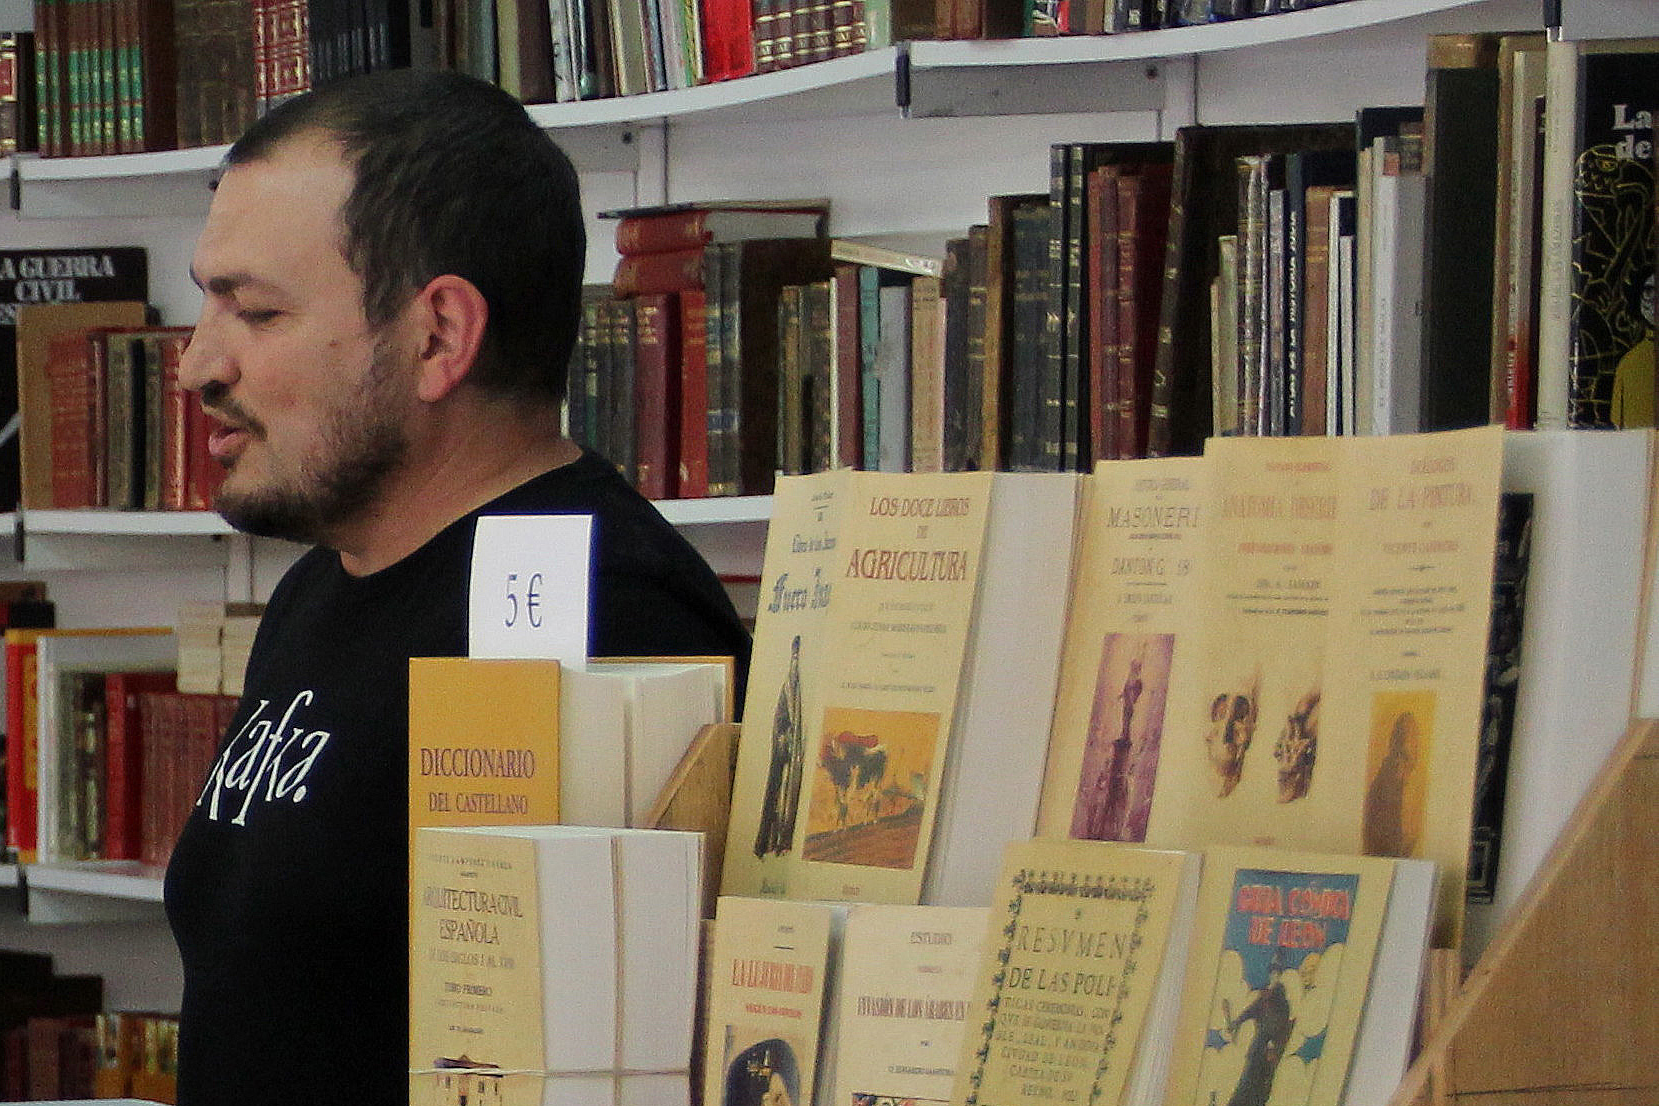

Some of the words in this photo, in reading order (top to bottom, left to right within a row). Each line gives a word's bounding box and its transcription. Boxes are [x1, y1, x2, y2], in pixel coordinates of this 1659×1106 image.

[19, 254, 115, 279] GUERRA
[869, 496, 898, 517] LOS
[901, 497, 932, 518] DOCE
[845, 548, 968, 582] AGRICULTURA
[420, 747, 536, 780] DICCIONARIO
[428, 791, 452, 813] DEL
[455, 792, 530, 816] CASTELLANO
[439, 917, 501, 946] ESPAÑOLA
[1014, 925, 1127, 960] RESVMEN
[1008, 966, 1033, 990] DE
[1037, 968, 1070, 993] LAS
